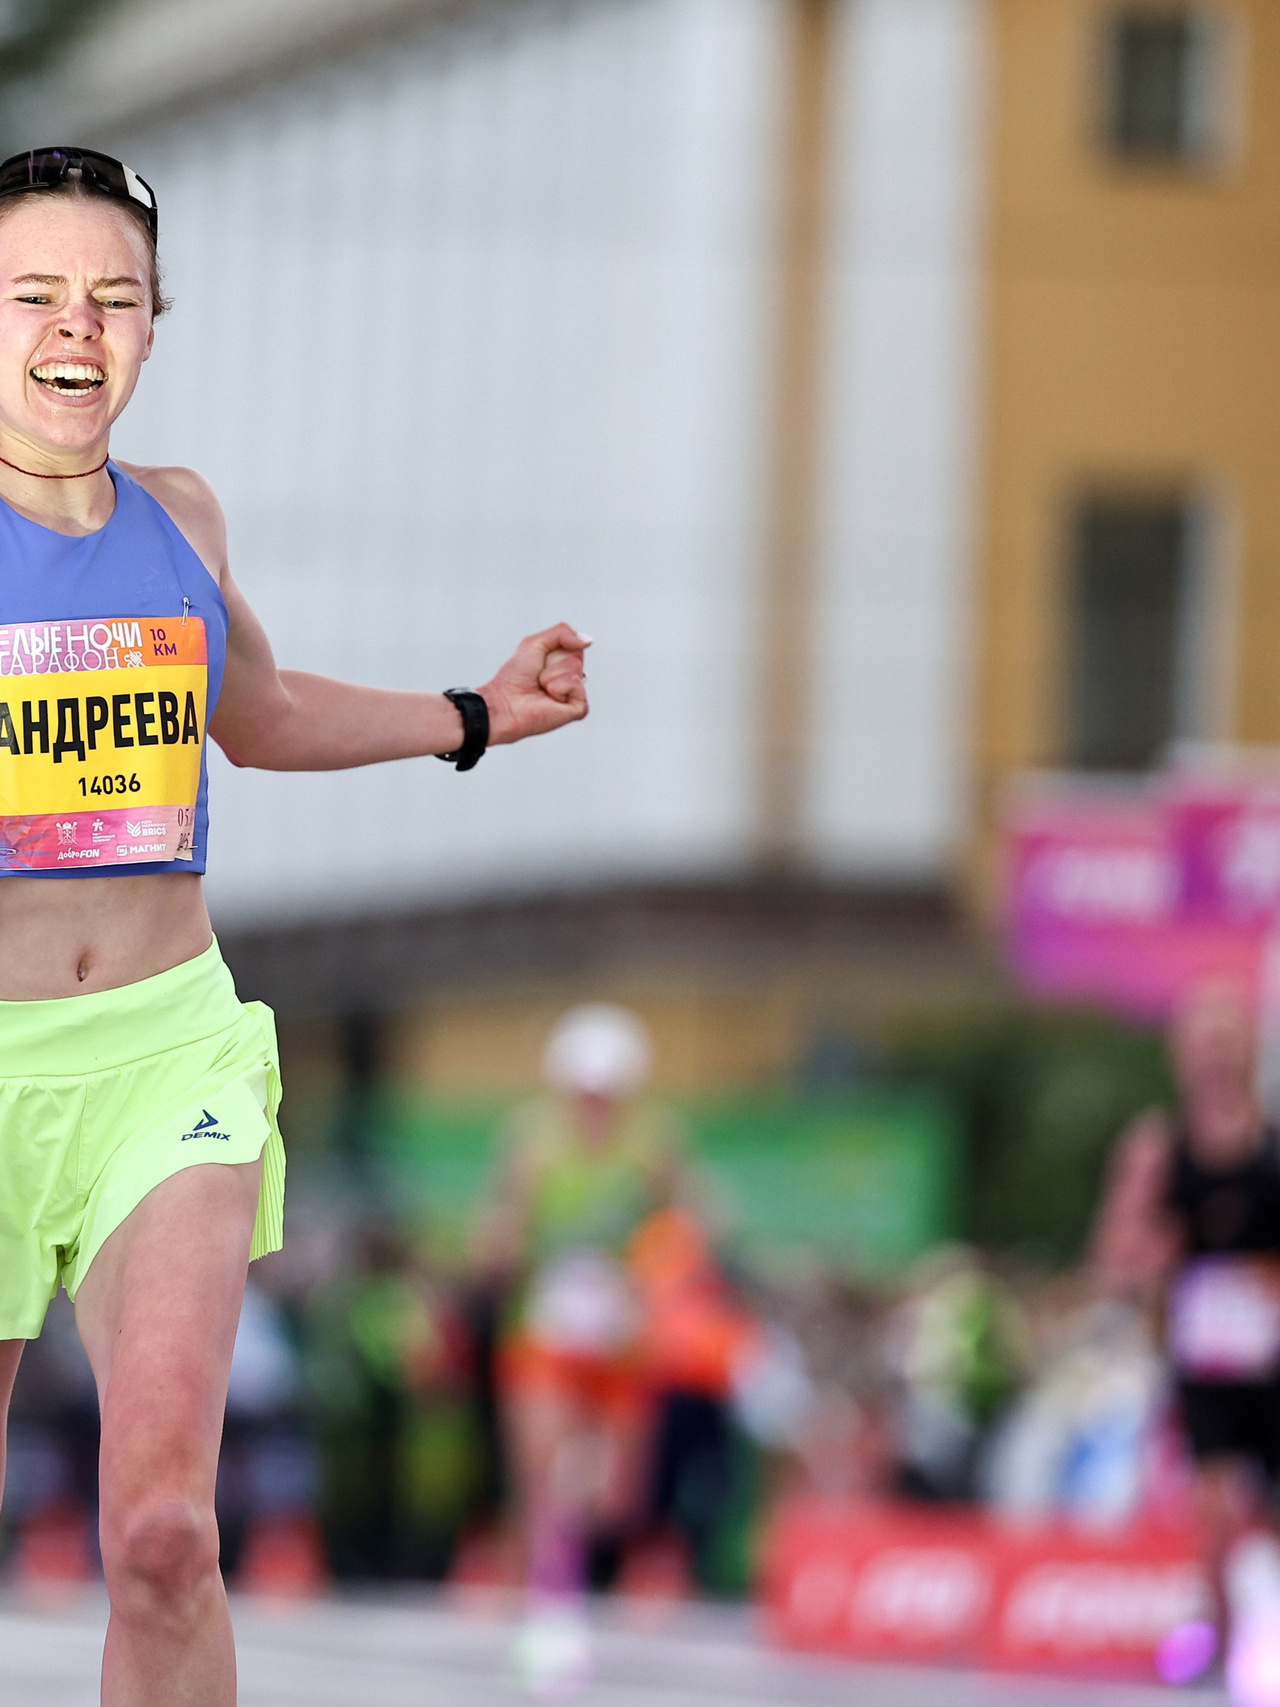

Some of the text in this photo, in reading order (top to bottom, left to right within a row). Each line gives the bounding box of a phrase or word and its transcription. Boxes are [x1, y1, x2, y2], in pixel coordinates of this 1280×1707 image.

[67, 621, 143, 652] НОЧИ
[149, 628, 167, 642] 10
[154, 643, 178, 656] КМ
[78, 773, 141, 796] 14036
[141, 827, 167, 836] BRICS
[129, 843, 167, 854] МАГНИТ
[181, 1131, 231, 1141] DEMIX
